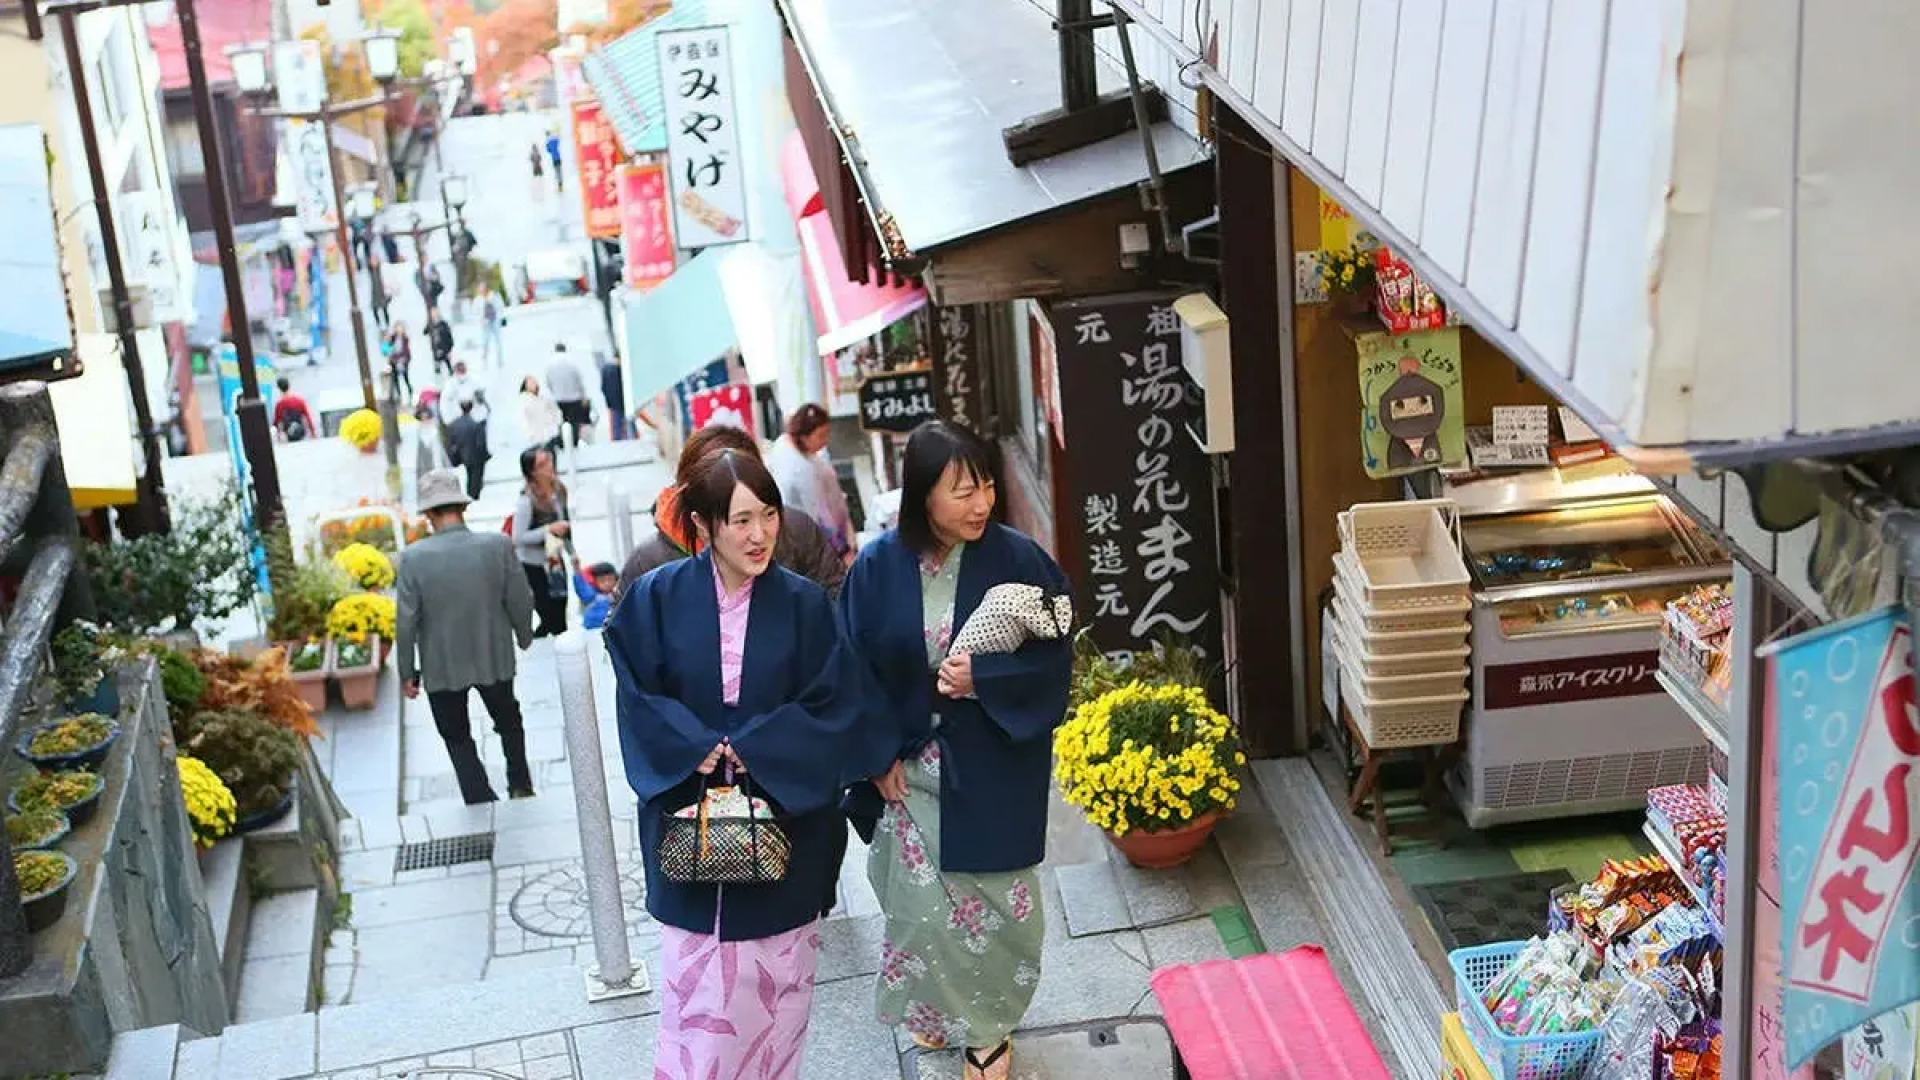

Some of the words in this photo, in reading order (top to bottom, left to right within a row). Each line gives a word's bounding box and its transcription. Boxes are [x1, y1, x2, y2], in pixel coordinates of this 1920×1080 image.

[678, 67, 729, 188] みやげ
[863, 393, 936, 420] すみよし
[1084, 492, 1130, 617] 製造元
[1119, 342, 1209, 662] 湯の花まん
